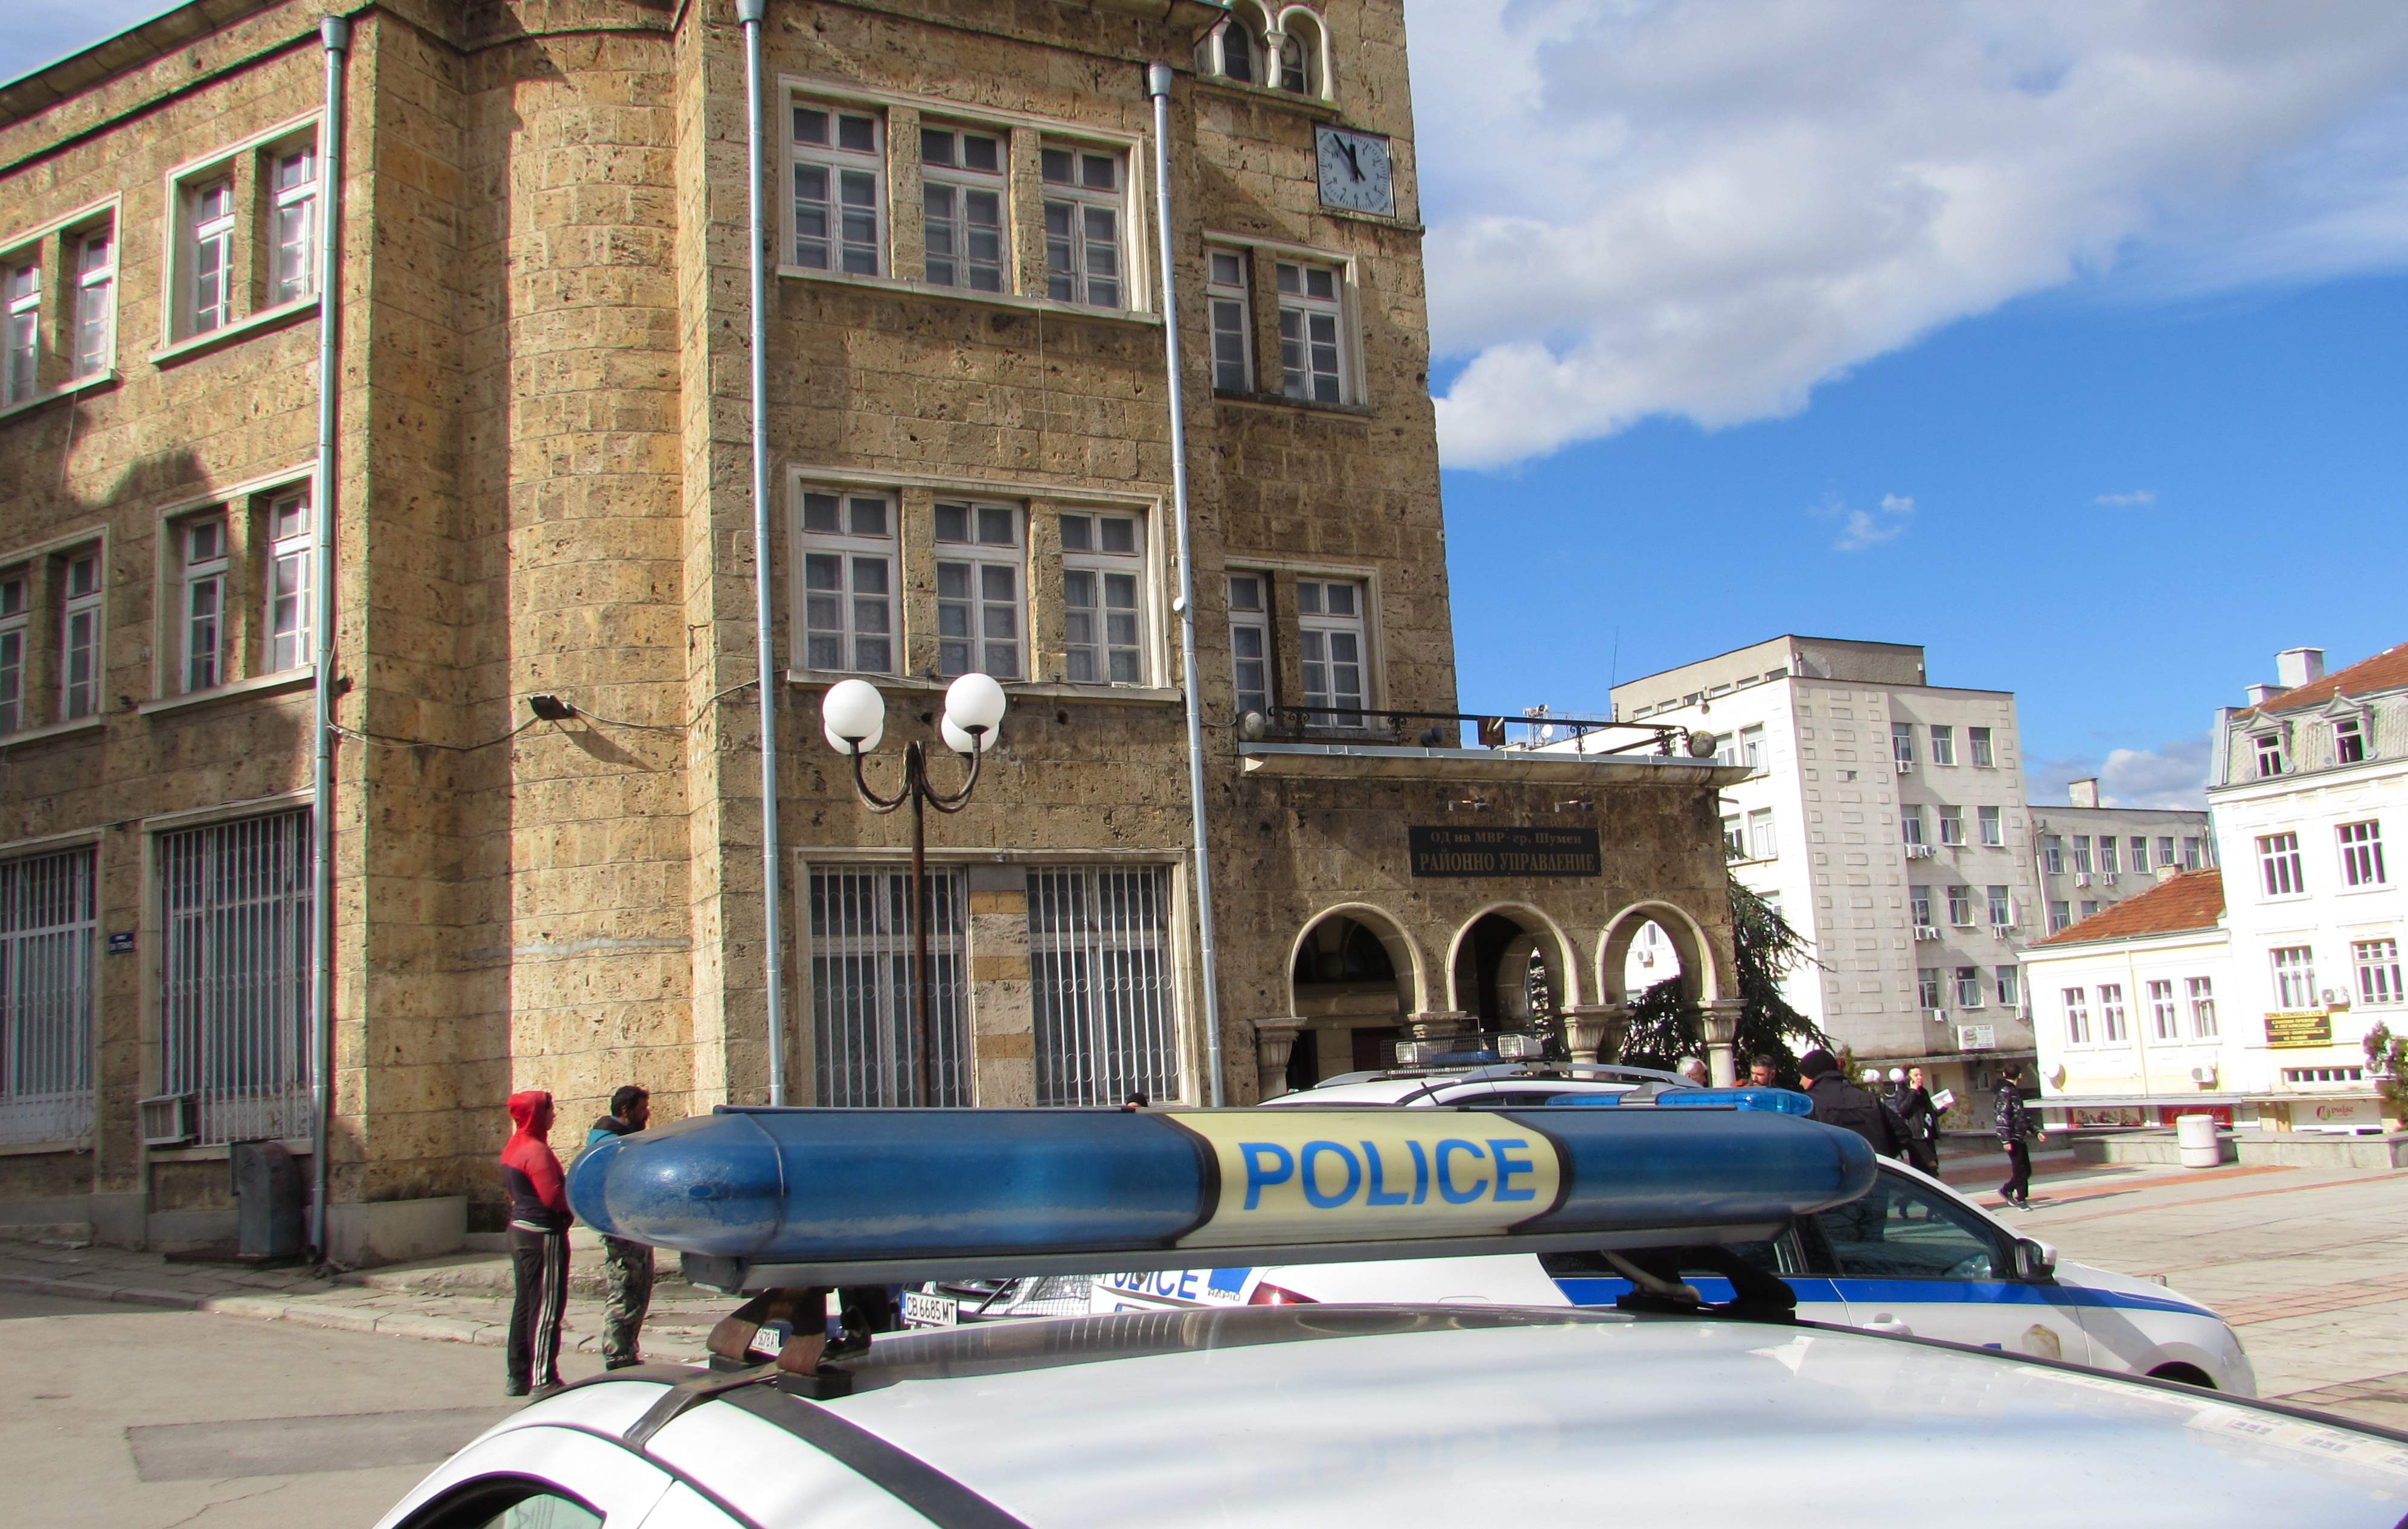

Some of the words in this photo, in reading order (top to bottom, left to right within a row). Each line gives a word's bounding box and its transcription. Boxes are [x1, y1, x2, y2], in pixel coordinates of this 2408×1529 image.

[1430, 832, 1450, 844] ОД
[1454, 834, 1471, 842] на
[1535, 832, 1582, 846] Шумен
[1419, 848, 1494, 871] РАЙОННО
[1499, 852, 1595, 871] УПРАВЛЕНИЕ
[1237, 1138, 1537, 1210] POLICE
[1208, 1289, 1240, 1301] RAPID
[920, 1298, 941, 1320] 6685
[943, 1301, 955, 1323] MT
